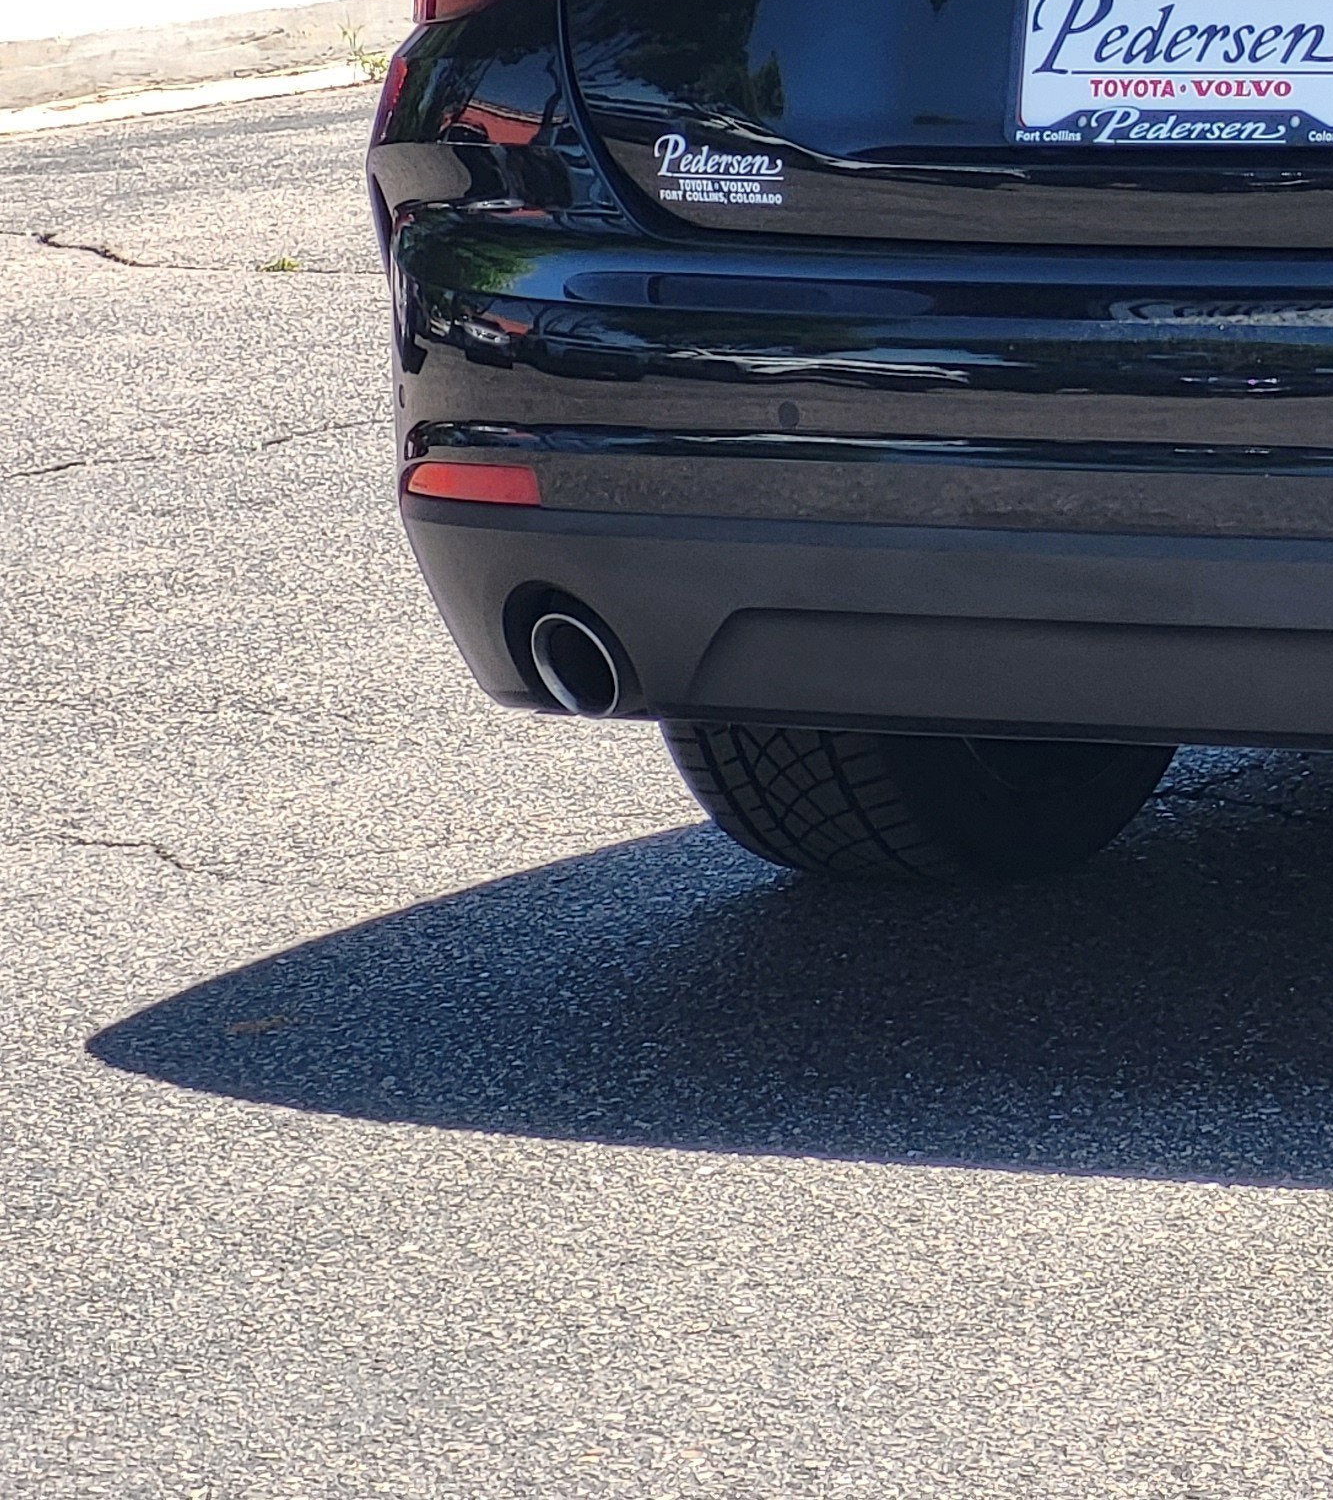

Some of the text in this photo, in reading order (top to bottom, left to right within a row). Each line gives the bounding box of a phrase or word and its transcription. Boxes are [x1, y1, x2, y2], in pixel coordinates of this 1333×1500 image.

[1090, 78, 1292, 98] TOYOTA VOLVO
[1090, 105, 1287, 143] Pedersen
[1015, 129, 1082, 142] Fort Collins
[654, 133, 783, 176] Pedersen
[678, 179, 760, 193] TOYOTA VOLVO
[659, 190, 683, 202] FORT
[729, 192, 783, 205] COLORADO
